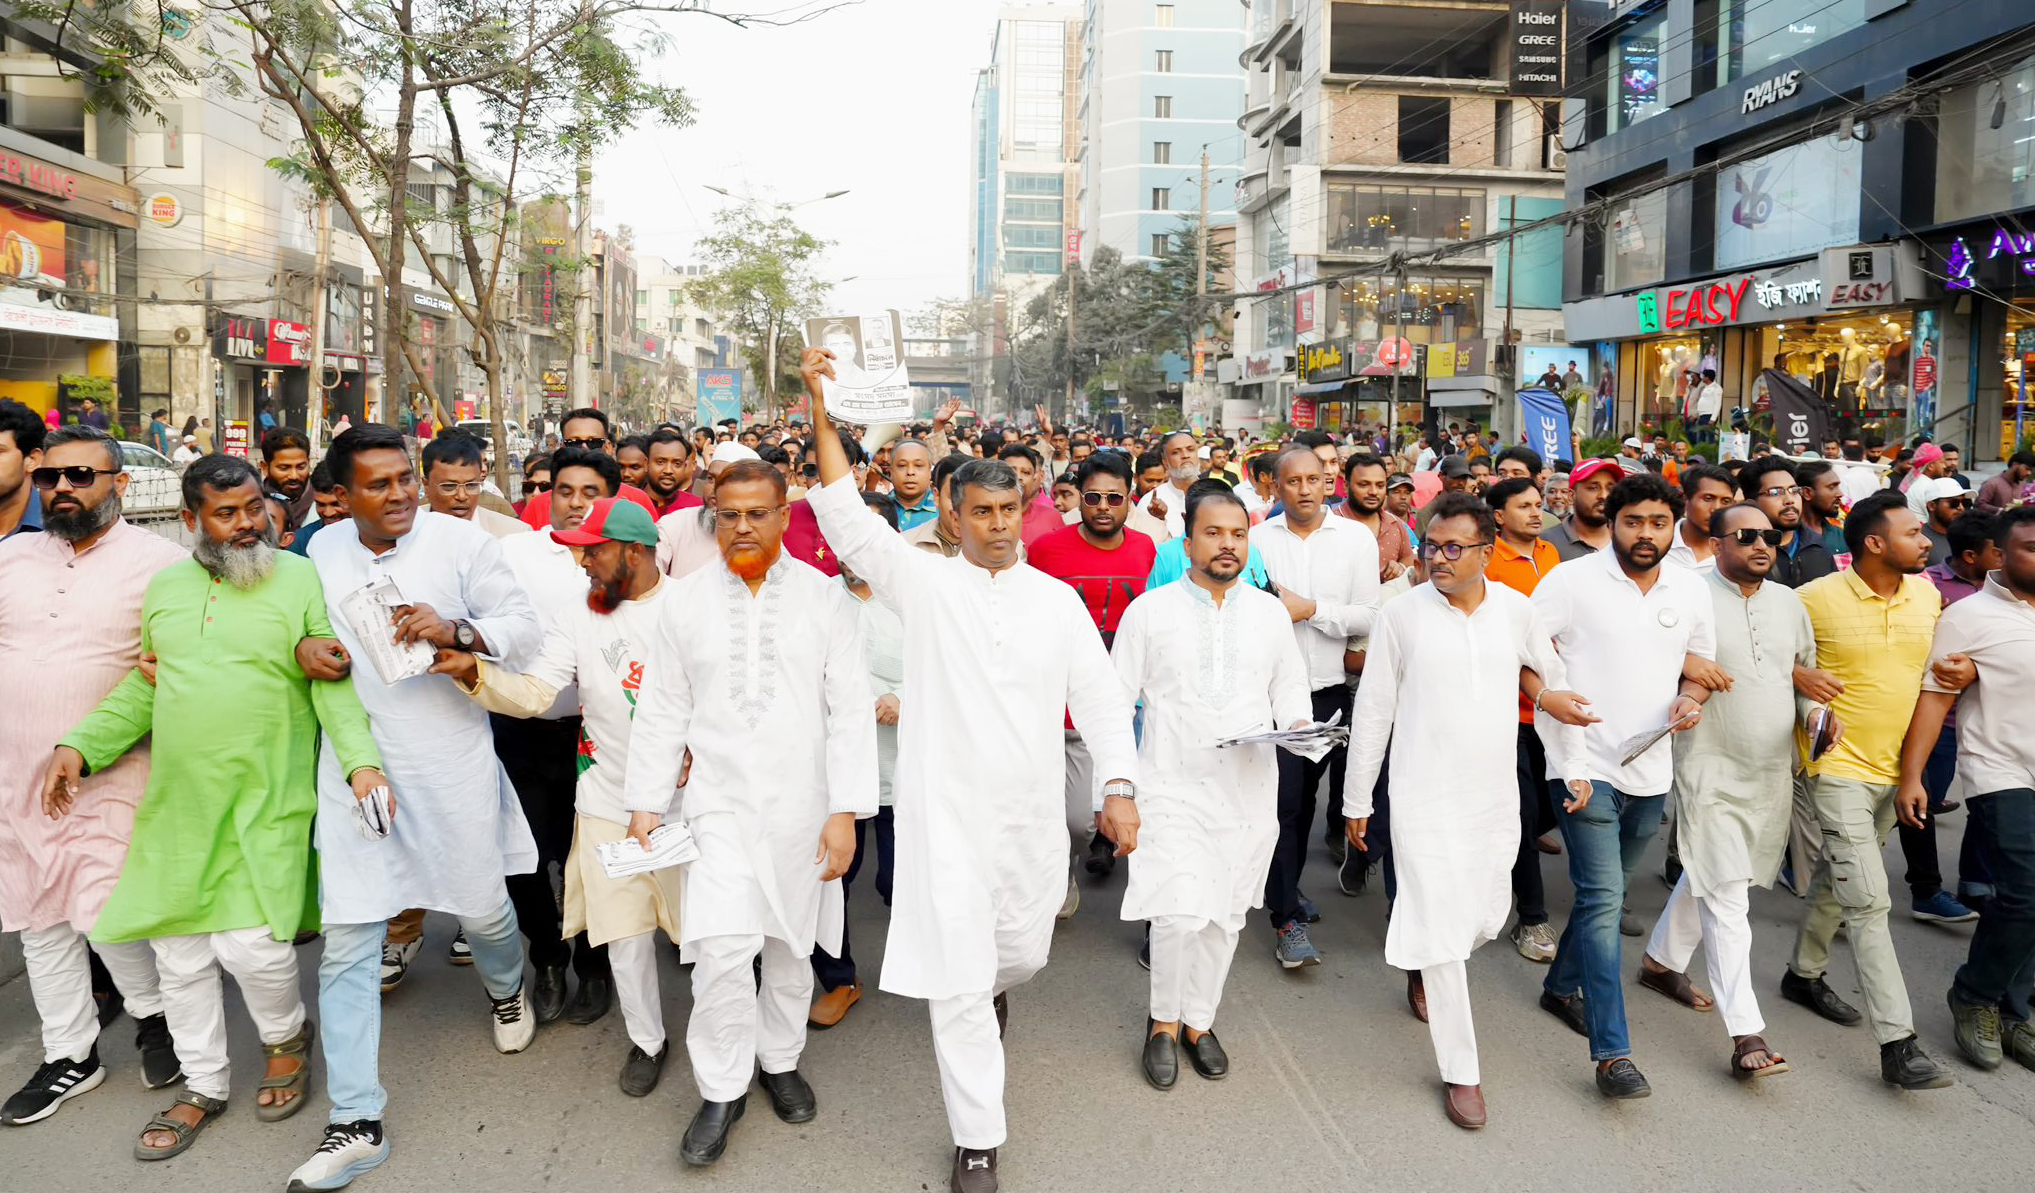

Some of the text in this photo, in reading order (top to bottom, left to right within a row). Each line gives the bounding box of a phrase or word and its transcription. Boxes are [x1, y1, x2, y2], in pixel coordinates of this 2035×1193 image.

[1518, 12, 1556, 25] Haier
[1518, 35, 1556, 45] GREE
[1518, 55, 1557, 64] SAMSUNG
[1518, 74, 1557, 82] HITACHI
[1741, 69, 1802, 114] RYANS
[29, 164, 76, 200] KING
[152, 208, 175, 217] KING
[535, 236, 565, 246] VIRGO
[1755, 278, 1783, 310] ইজি
[1831, 281, 1893, 304] EASY
[1665, 278, 1749, 329] EASY
[225, 428, 247, 439] 999
[1787, 412, 1811, 445] ier
